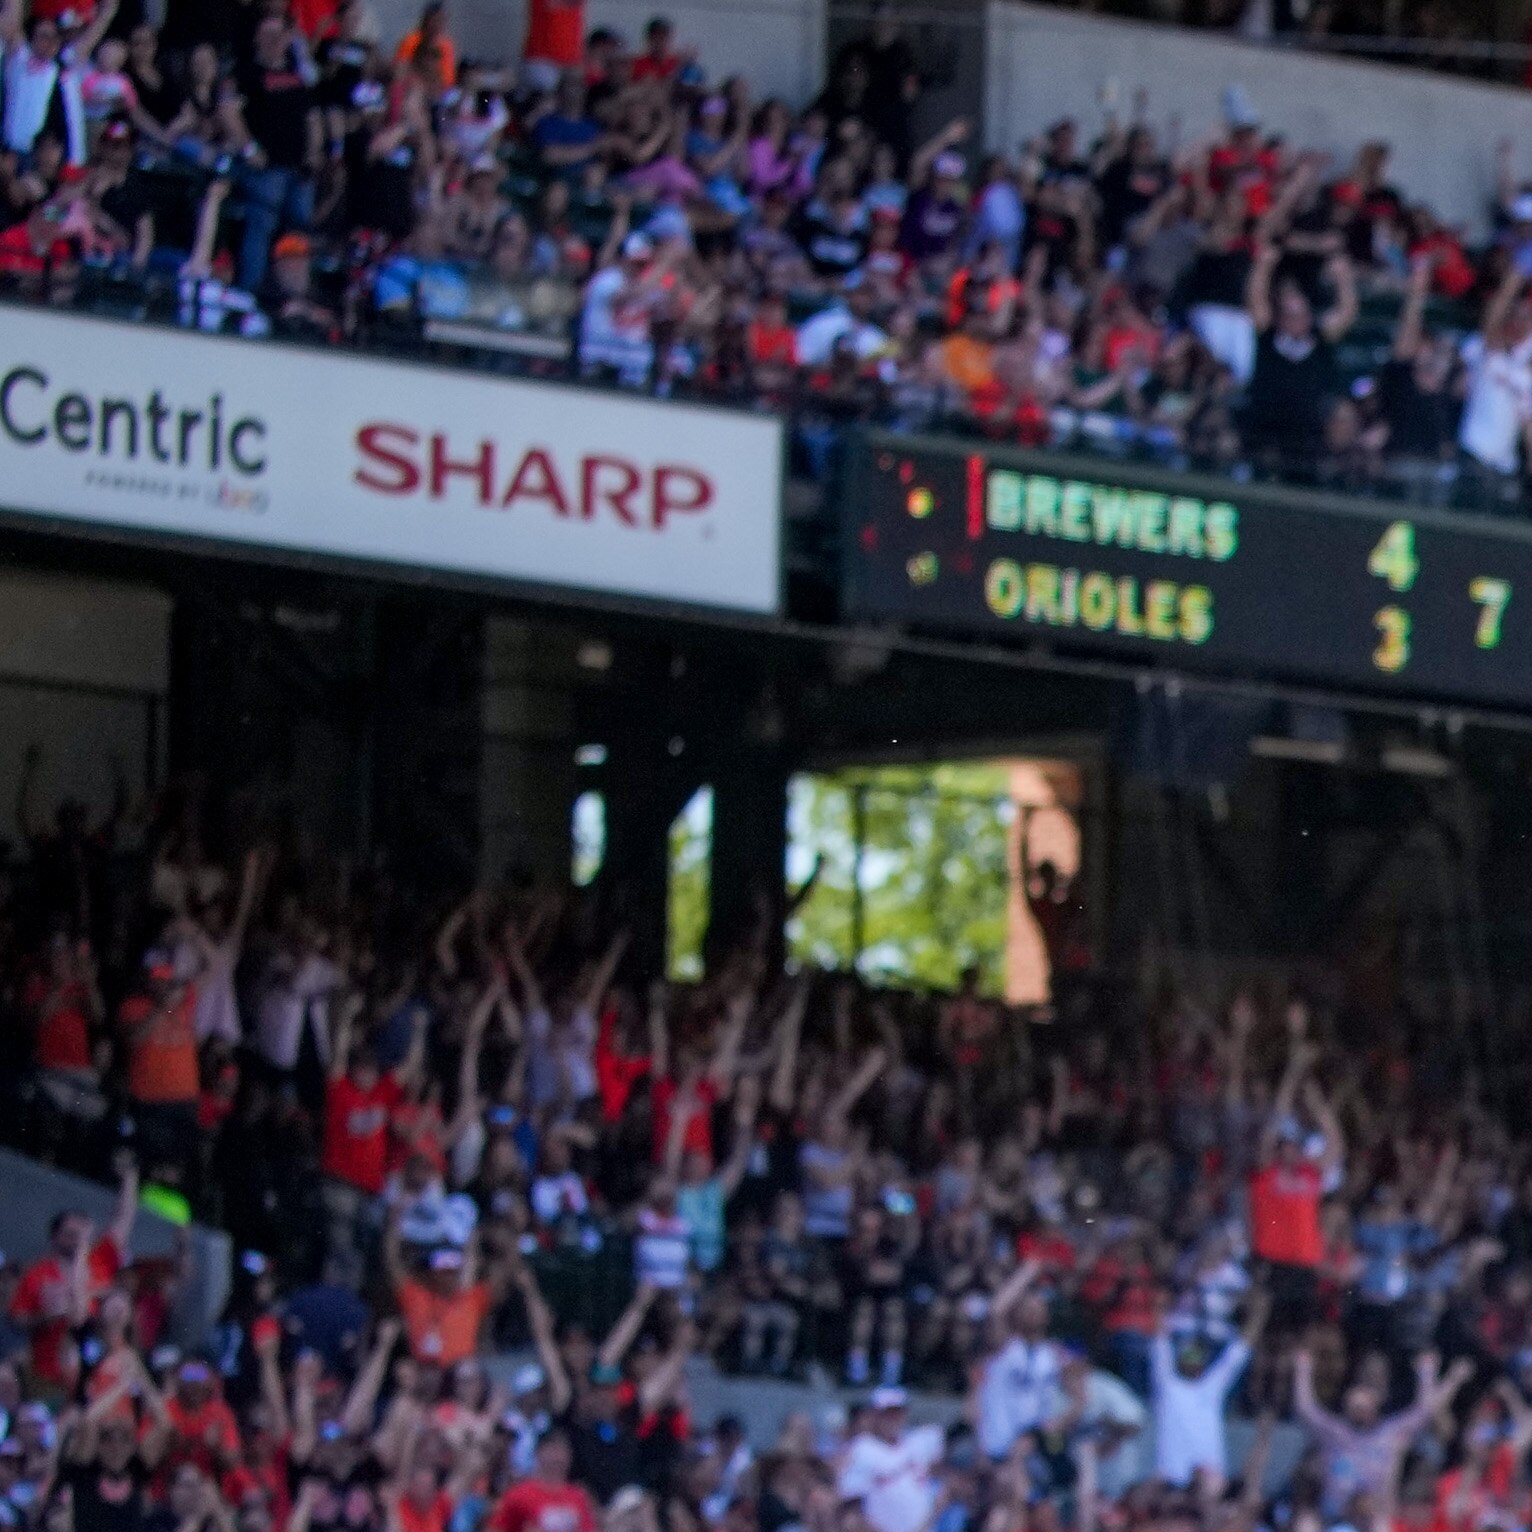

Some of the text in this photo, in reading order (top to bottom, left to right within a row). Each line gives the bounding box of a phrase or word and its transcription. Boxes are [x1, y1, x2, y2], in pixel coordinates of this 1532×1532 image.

[0, 366, 269, 477] Centric
[354, 422, 715, 533] SHARP
[986, 468, 1419, 592] BREWERS 4
[984, 557, 1411, 673] ORIOLES 3
[1468, 577, 1513, 650] 7
